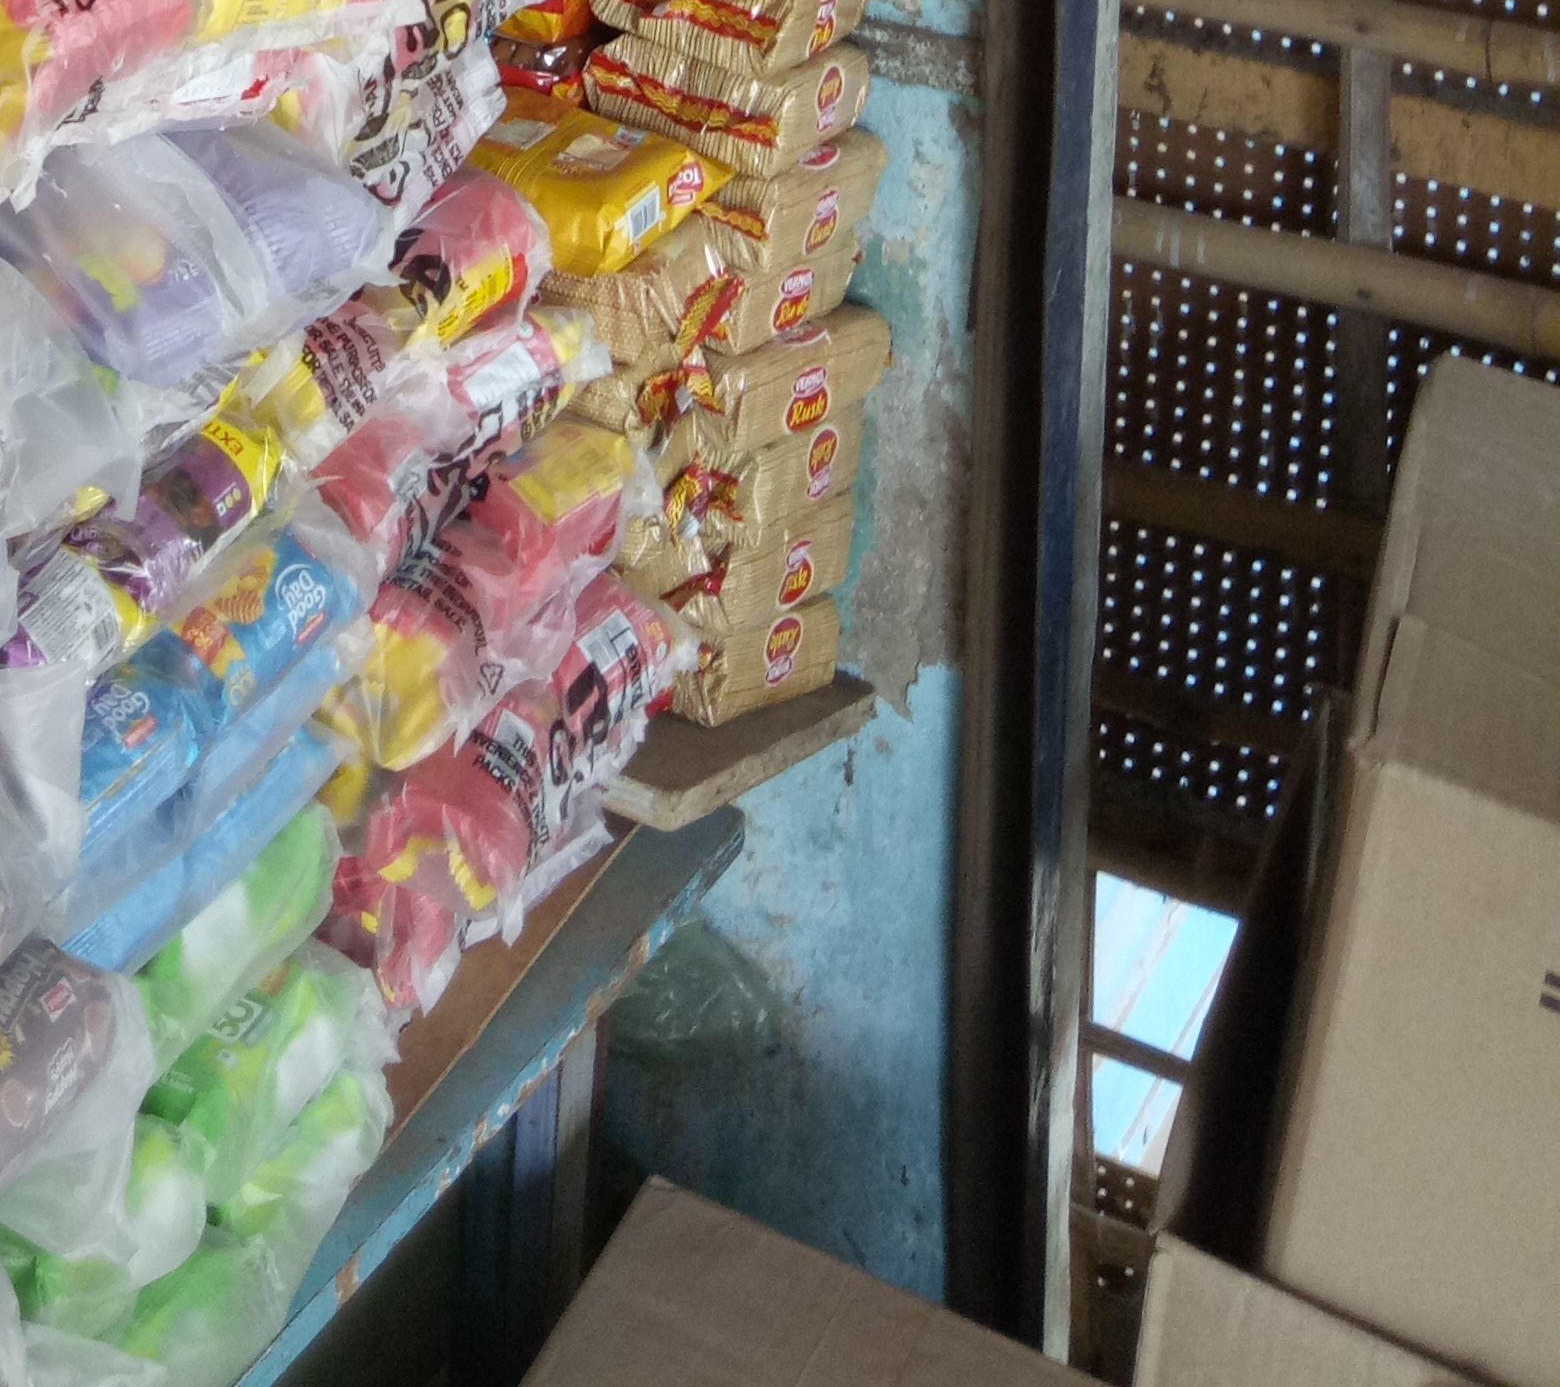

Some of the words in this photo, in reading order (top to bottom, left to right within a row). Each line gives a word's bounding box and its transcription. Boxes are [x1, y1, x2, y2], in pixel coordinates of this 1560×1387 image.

[789, 395, 826, 429] Rusk
[280, 568, 316, 608] Day
[286, 583, 327, 640] Good
[103, 689, 151, 743] Good
